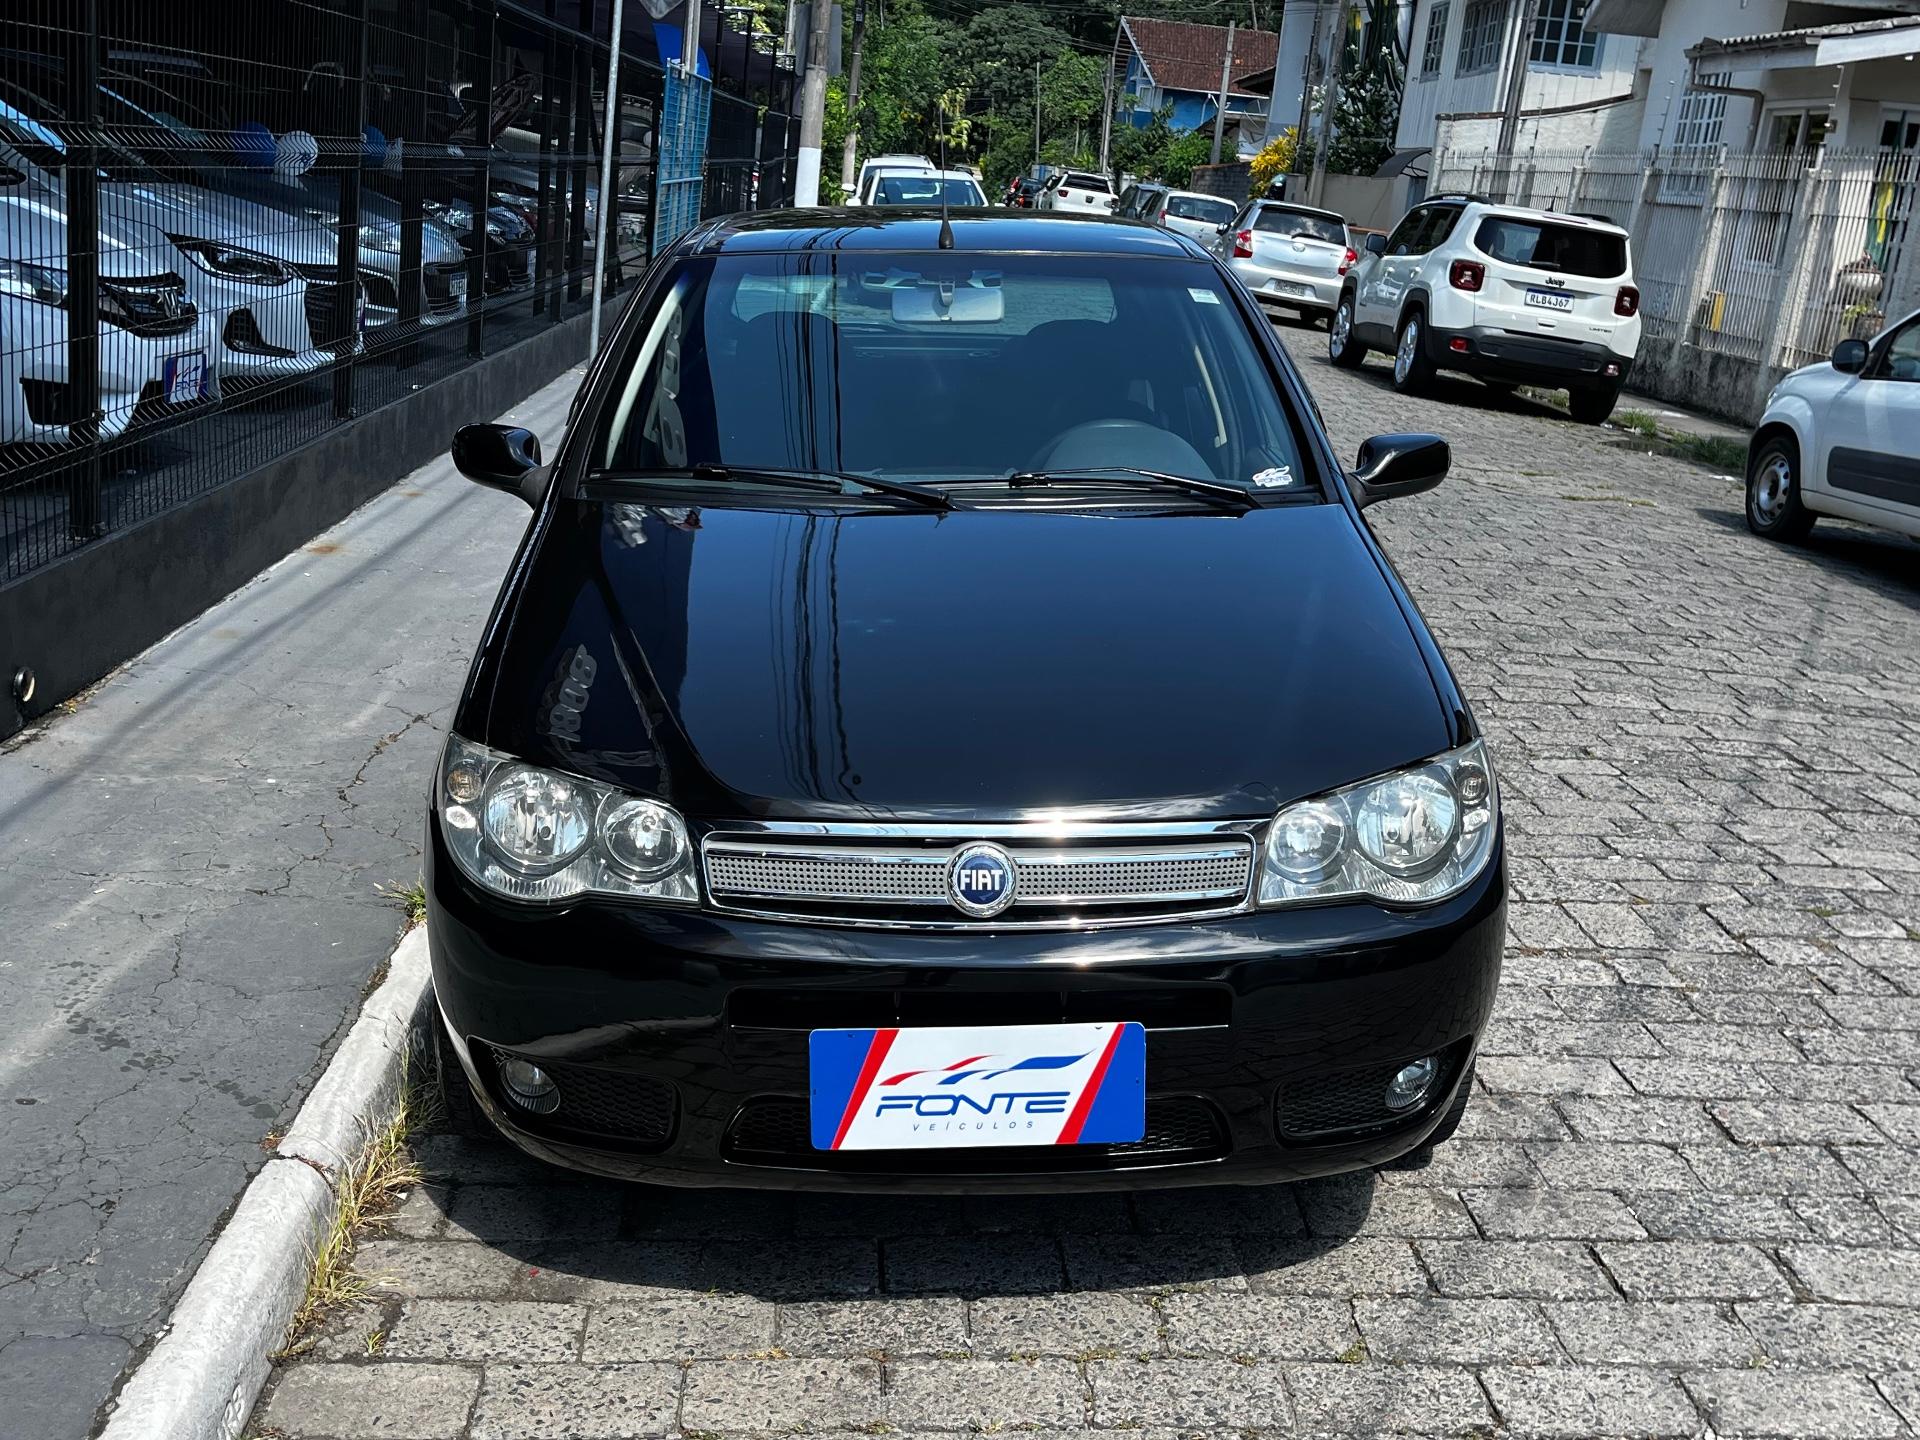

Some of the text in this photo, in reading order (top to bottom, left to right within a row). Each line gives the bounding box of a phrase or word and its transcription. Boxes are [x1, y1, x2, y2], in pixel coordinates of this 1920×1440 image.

[1530, 294, 1569, 308] RLB4J67
[960, 869, 1003, 891] FIAT
[875, 1091, 1071, 1117] FONTE
[913, 1121, 1034, 1132] VEÍCULOS
